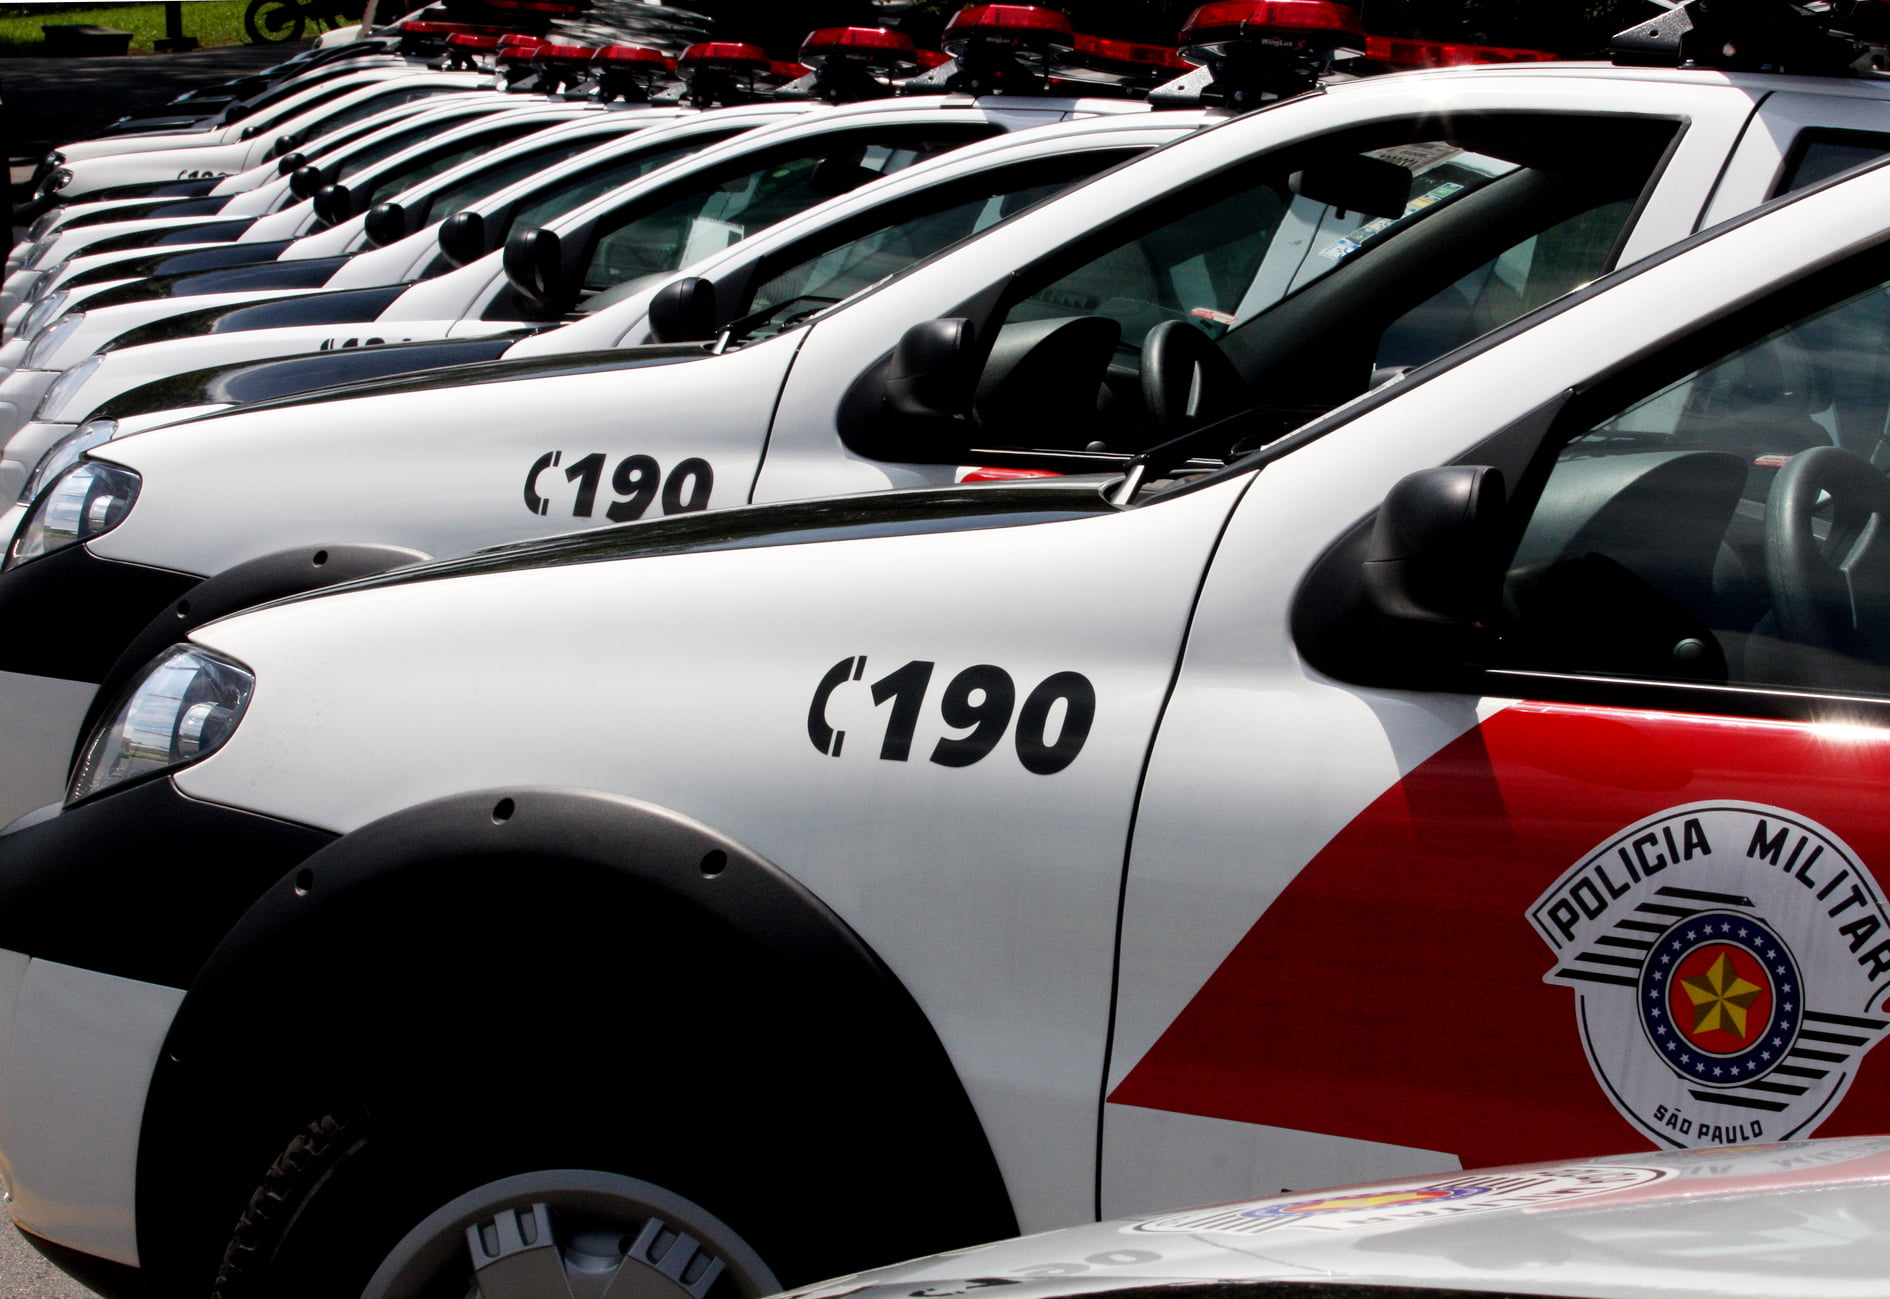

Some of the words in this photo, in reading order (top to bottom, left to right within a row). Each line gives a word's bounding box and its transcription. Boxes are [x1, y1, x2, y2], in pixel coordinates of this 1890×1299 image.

[564, 452, 714, 523] 190
[870, 660, 1096, 776] 190
[1547, 818, 1712, 942] POLICIA
[1746, 819, 1890, 982] MILITAR
[1653, 1104, 1692, 1135] SÃO
[1697, 1120, 1763, 1145] PAULO
